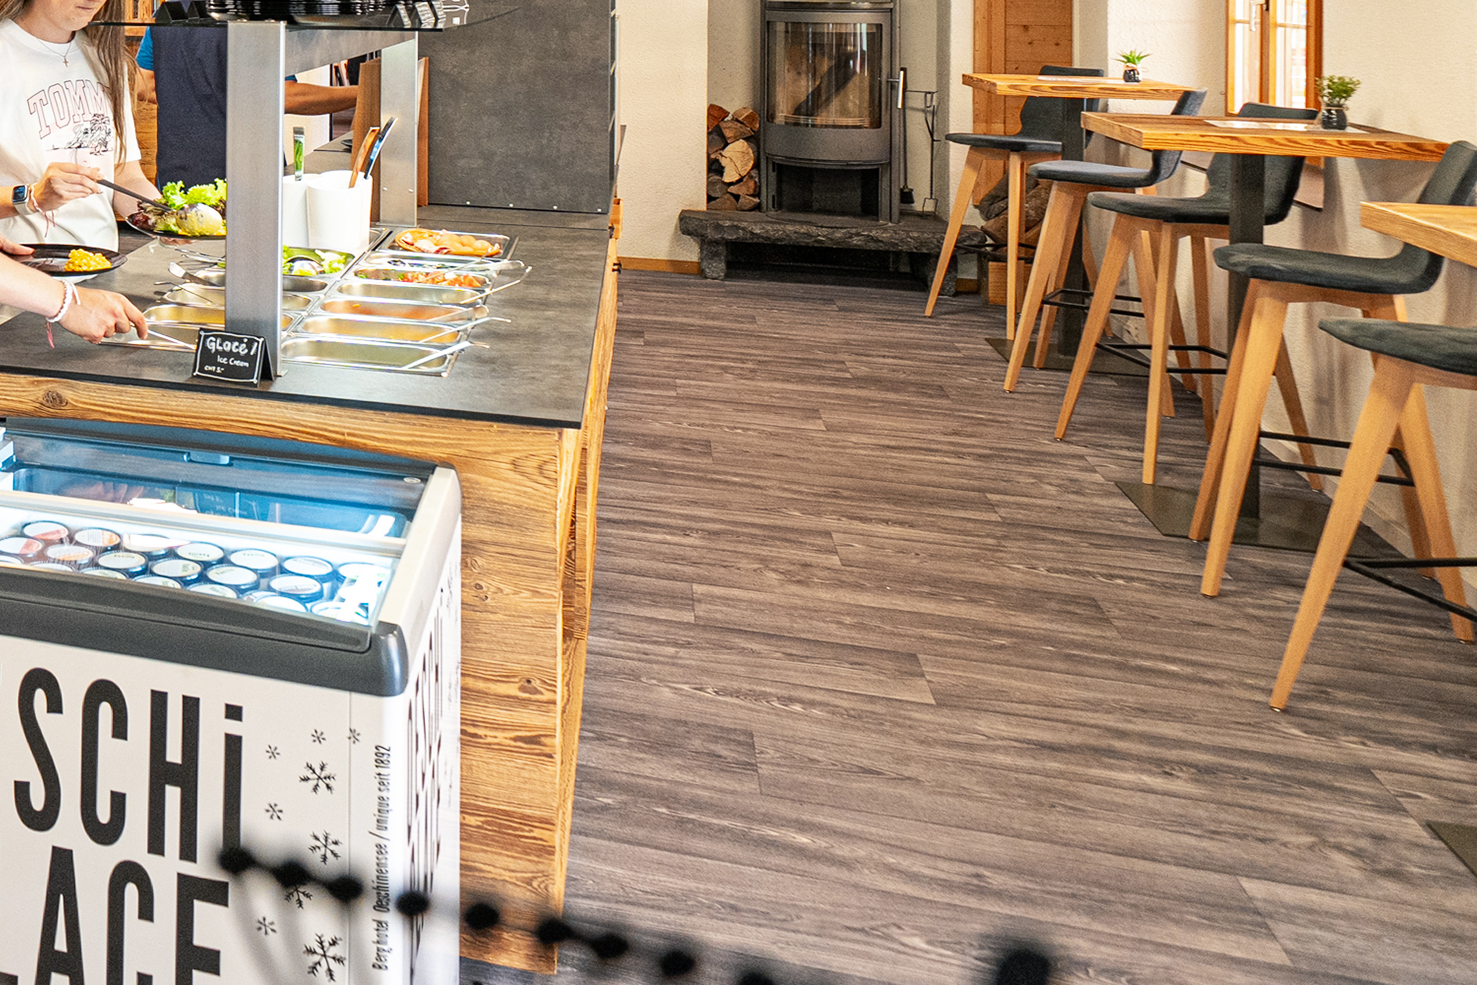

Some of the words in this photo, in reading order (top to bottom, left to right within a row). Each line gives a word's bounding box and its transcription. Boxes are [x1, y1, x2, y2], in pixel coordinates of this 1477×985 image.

[27, 80, 112, 140] TOMM
[374, 744, 391, 769] 1892
[374, 772, 390, 793] seit
[372, 796, 392, 831] unique
[372, 842, 391, 914] Oeschinensee
[372, 918, 392, 971] Berghotel
